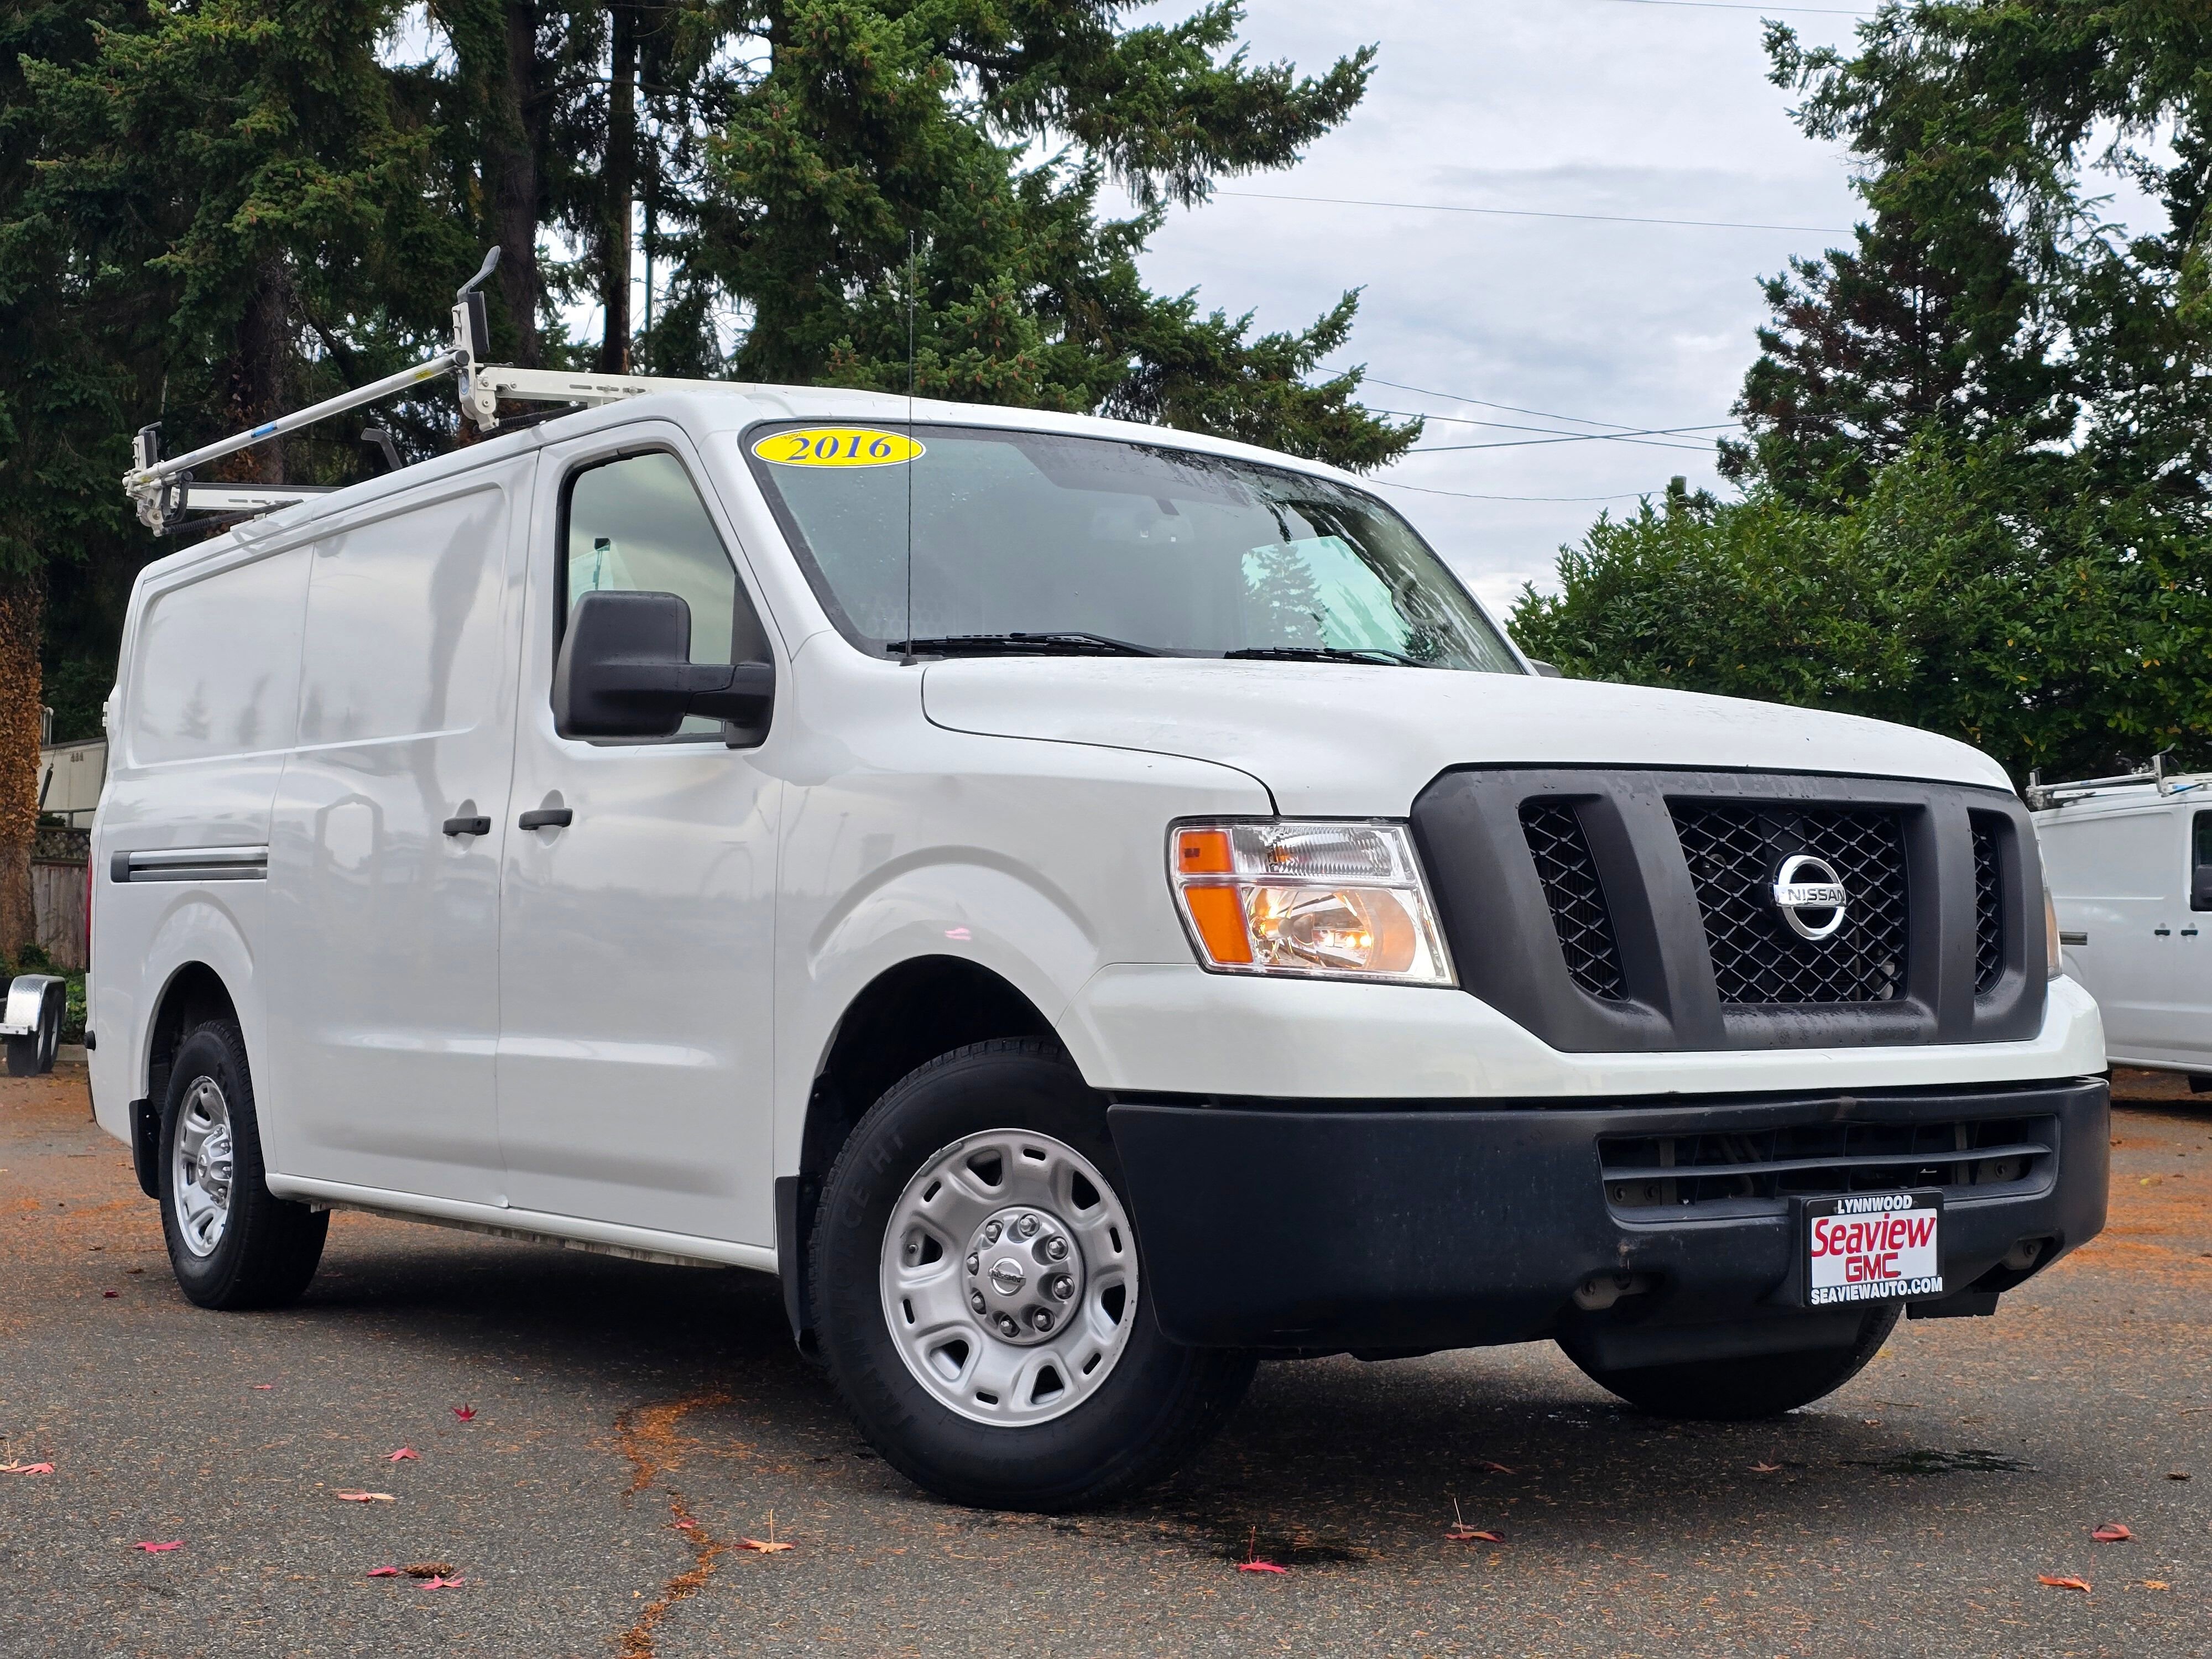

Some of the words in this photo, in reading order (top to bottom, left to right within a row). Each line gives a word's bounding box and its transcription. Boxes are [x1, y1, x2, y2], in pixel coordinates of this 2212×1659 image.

[786, 435, 893, 461] 2016
[1787, 888, 1845, 901] NISSAN
[1837, 1195, 1913, 1214] LYNNWOOD
[1811, 1213, 1936, 1258] Seaview
[1845, 1252, 1902, 1282] GMC
[1811, 1276, 1943, 1305] SEAVIEWAUTO.COM
